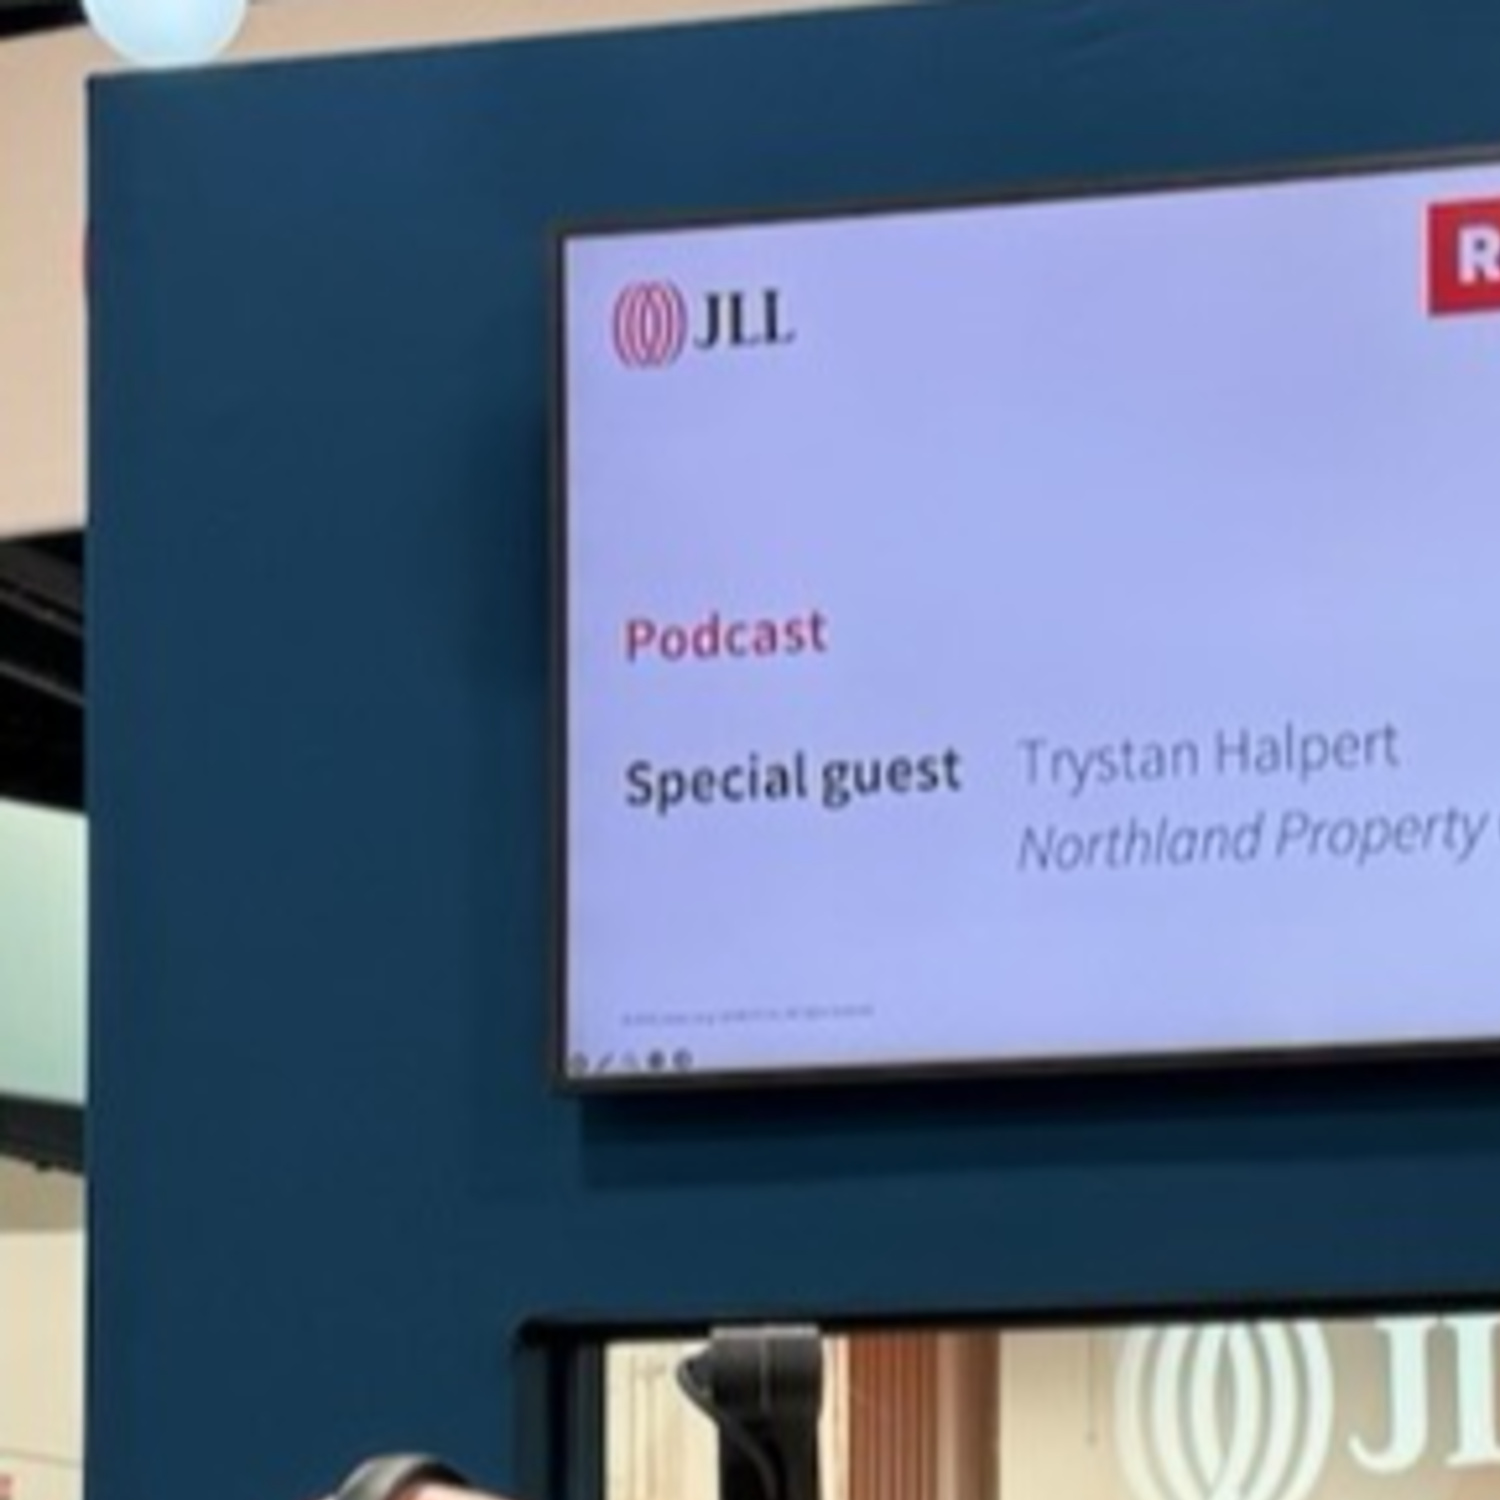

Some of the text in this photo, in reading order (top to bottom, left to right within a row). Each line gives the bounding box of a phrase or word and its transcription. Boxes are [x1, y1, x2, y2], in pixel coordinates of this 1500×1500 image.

[693, 289, 796, 350] JLL
[625, 610, 828, 662] Podcast
[625, 747, 962, 816] Special guest
[1018, 722, 1401, 797] Trystan Halpert
[1018, 812, 1265, 872] Northland
[1276, 803, 1490, 866] Property
